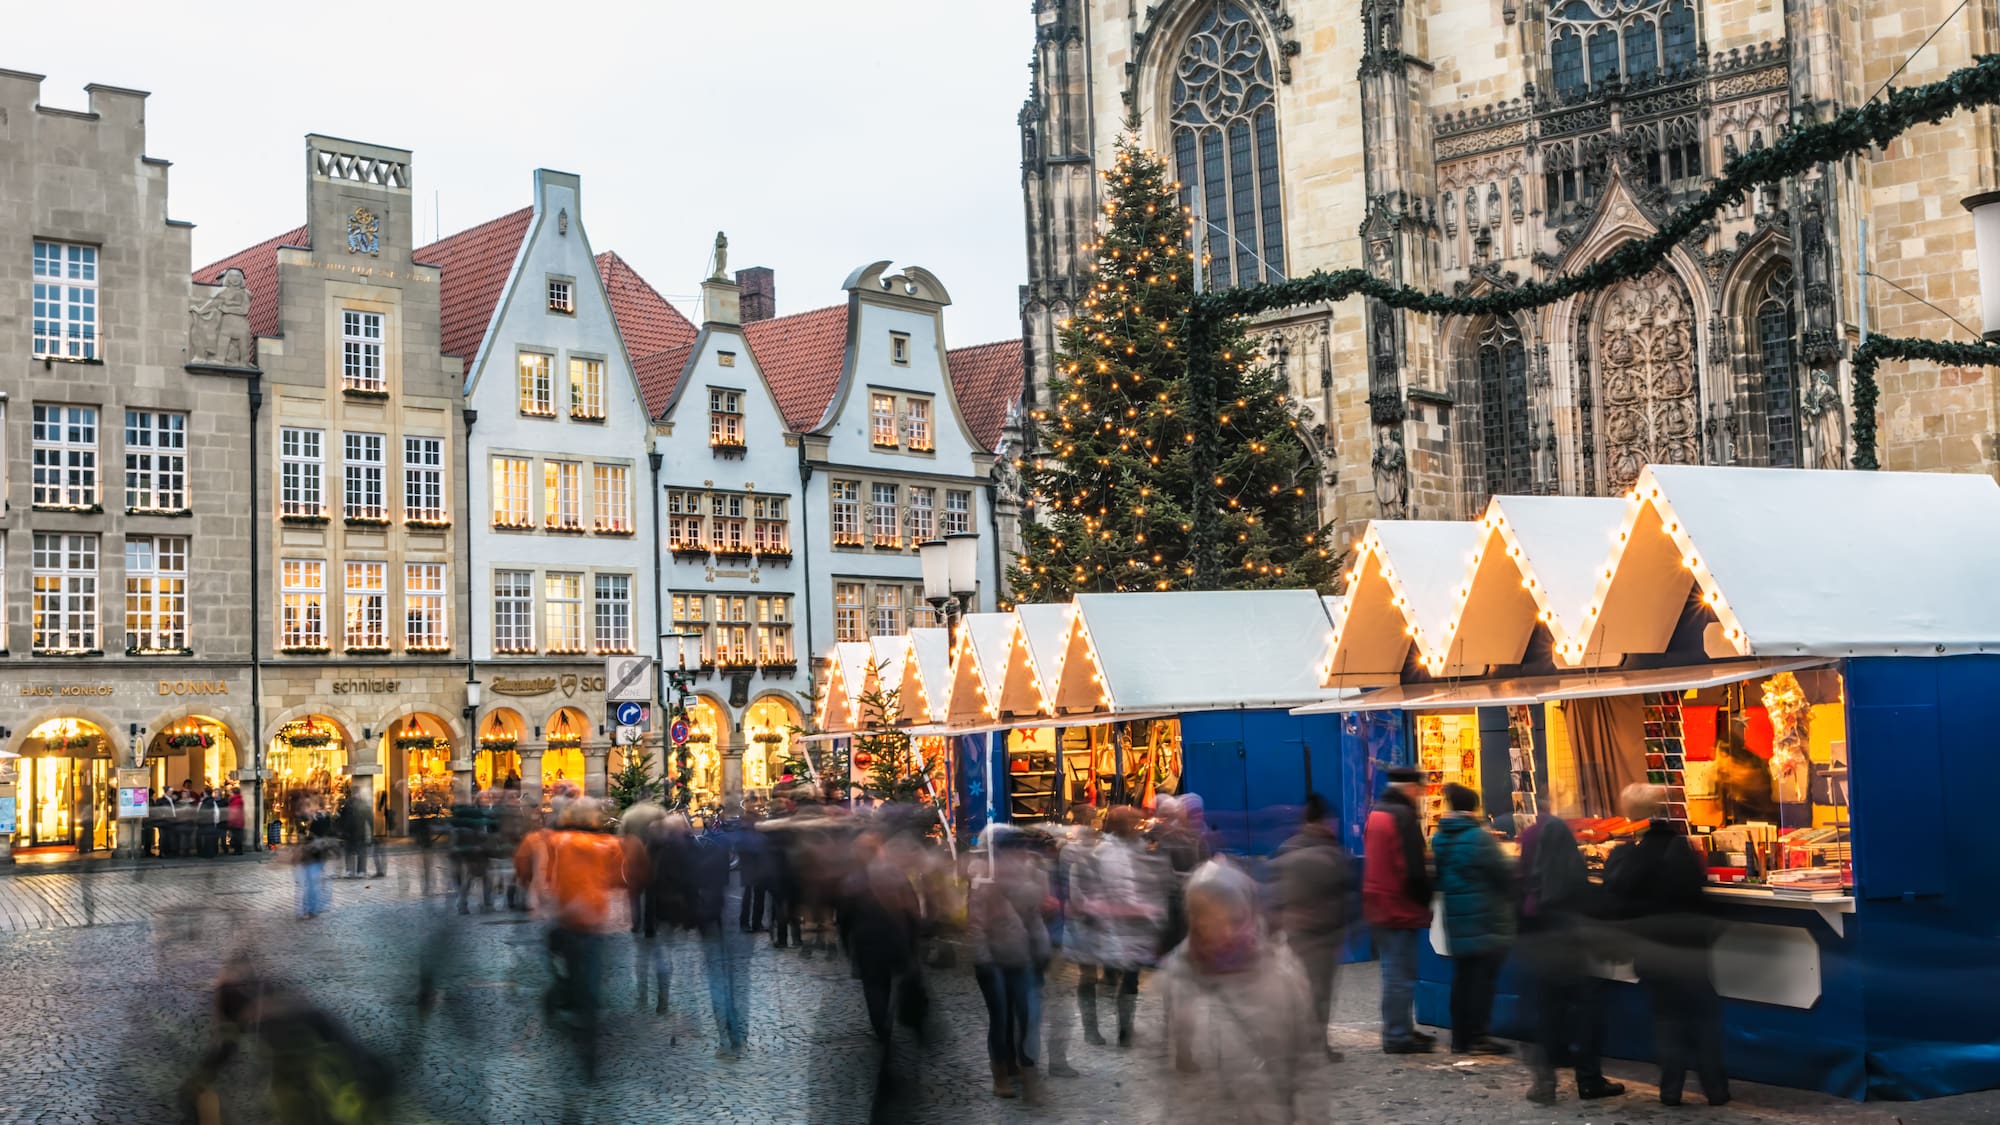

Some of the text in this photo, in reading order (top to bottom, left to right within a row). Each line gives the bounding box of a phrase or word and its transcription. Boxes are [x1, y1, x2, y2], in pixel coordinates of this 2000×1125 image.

[20, 686, 113, 696] HAUS MONHOF
[159, 680, 229, 696] DONNA
[333, 678, 401, 693] schnitzler
